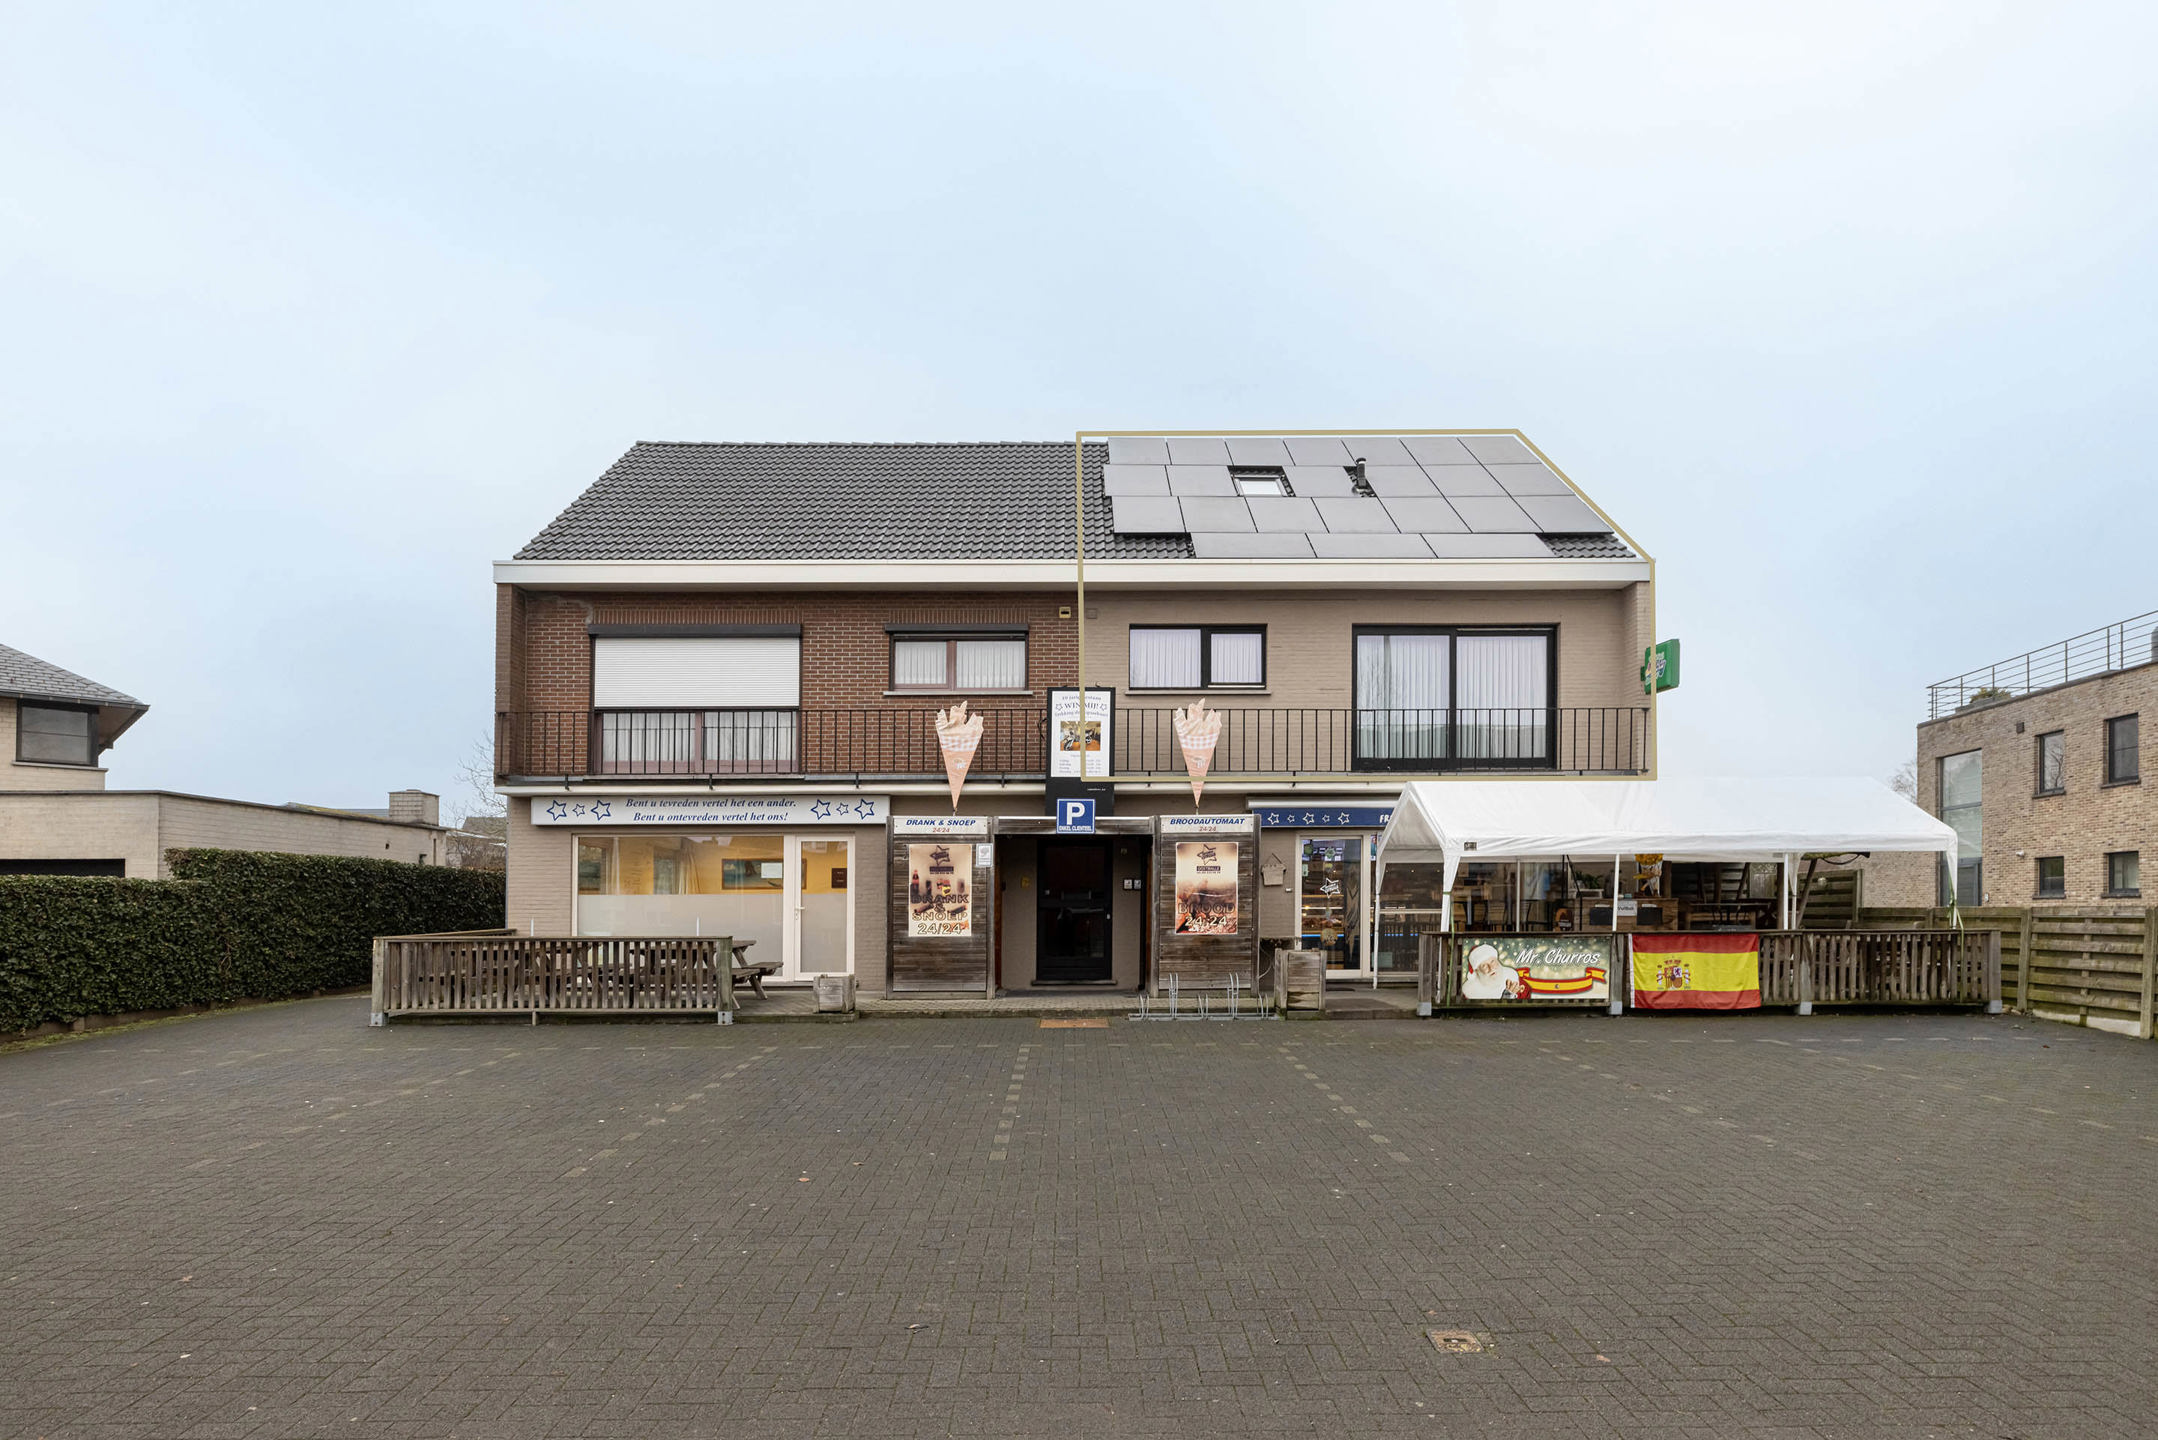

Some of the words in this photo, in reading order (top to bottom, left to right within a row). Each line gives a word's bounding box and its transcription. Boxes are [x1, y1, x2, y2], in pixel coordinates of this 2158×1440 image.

[625, 799, 648, 807] Bent
[659, 799, 699, 807] tevreden
[702, 798, 728, 807] vertel
[730, 798, 745, 807] het
[766, 799, 797, 807] ander.
[633, 812, 656, 821] Bent
[667, 812, 719, 821] ontevreden
[722, 812, 748, 821] vertel
[750, 812, 765, 821] het
[767, 812, 788, 821] ons!
[1066, 802, 1085, 825] P
[911, 894, 969, 904] DRANK
[934, 902, 946, 913] &
[1178, 902, 1236, 914] BROOD
[912, 911, 967, 921] SNOEP
[917, 922, 962, 935] 24/24
[1515, 950, 1541, 964] Mr.
[1545, 948, 1601, 964] Churros
